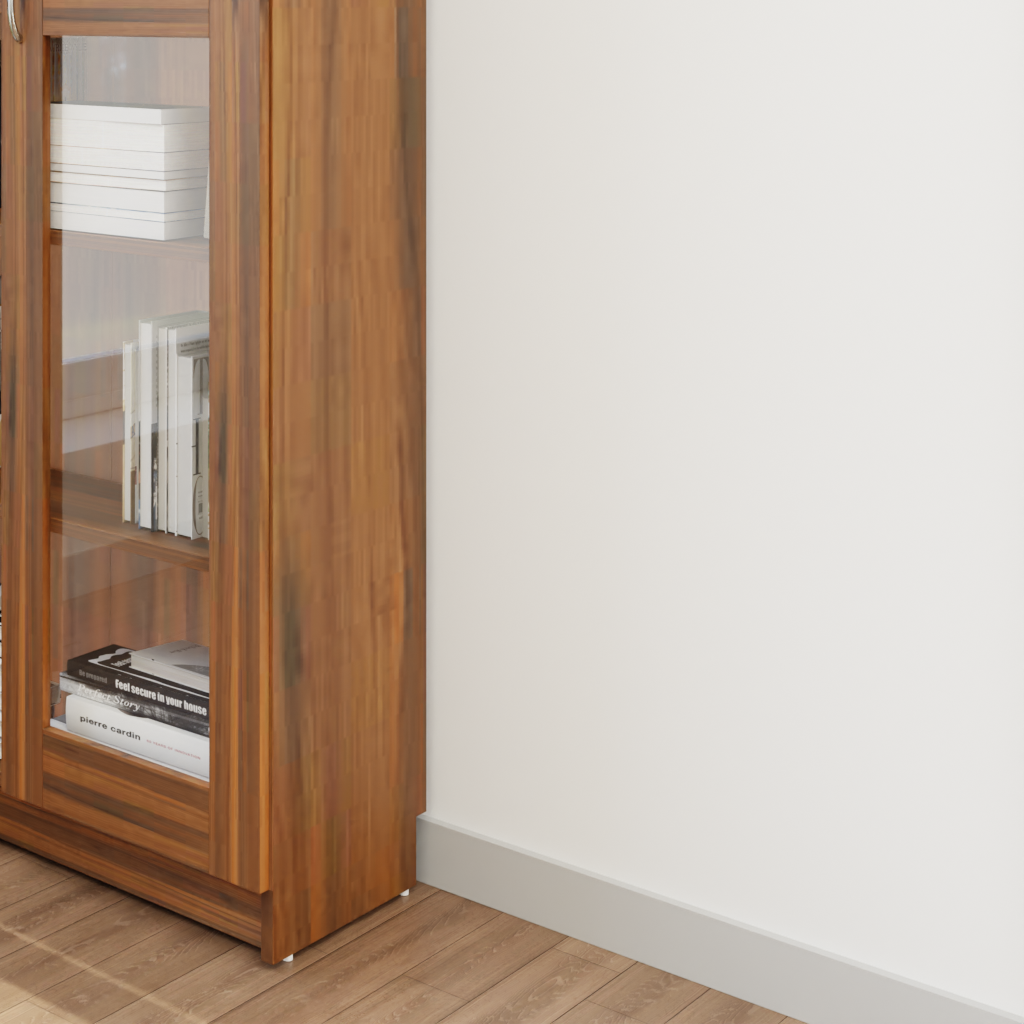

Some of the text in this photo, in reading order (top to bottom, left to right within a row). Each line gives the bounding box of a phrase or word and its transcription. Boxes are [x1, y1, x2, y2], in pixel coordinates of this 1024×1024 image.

[85, 672, 108, 684] prepared
[78, 684, 140, 711] Perfect Story
[115, 679, 207, 716] Feel secure in your house
[80, 715, 141, 740] pierre cardin
